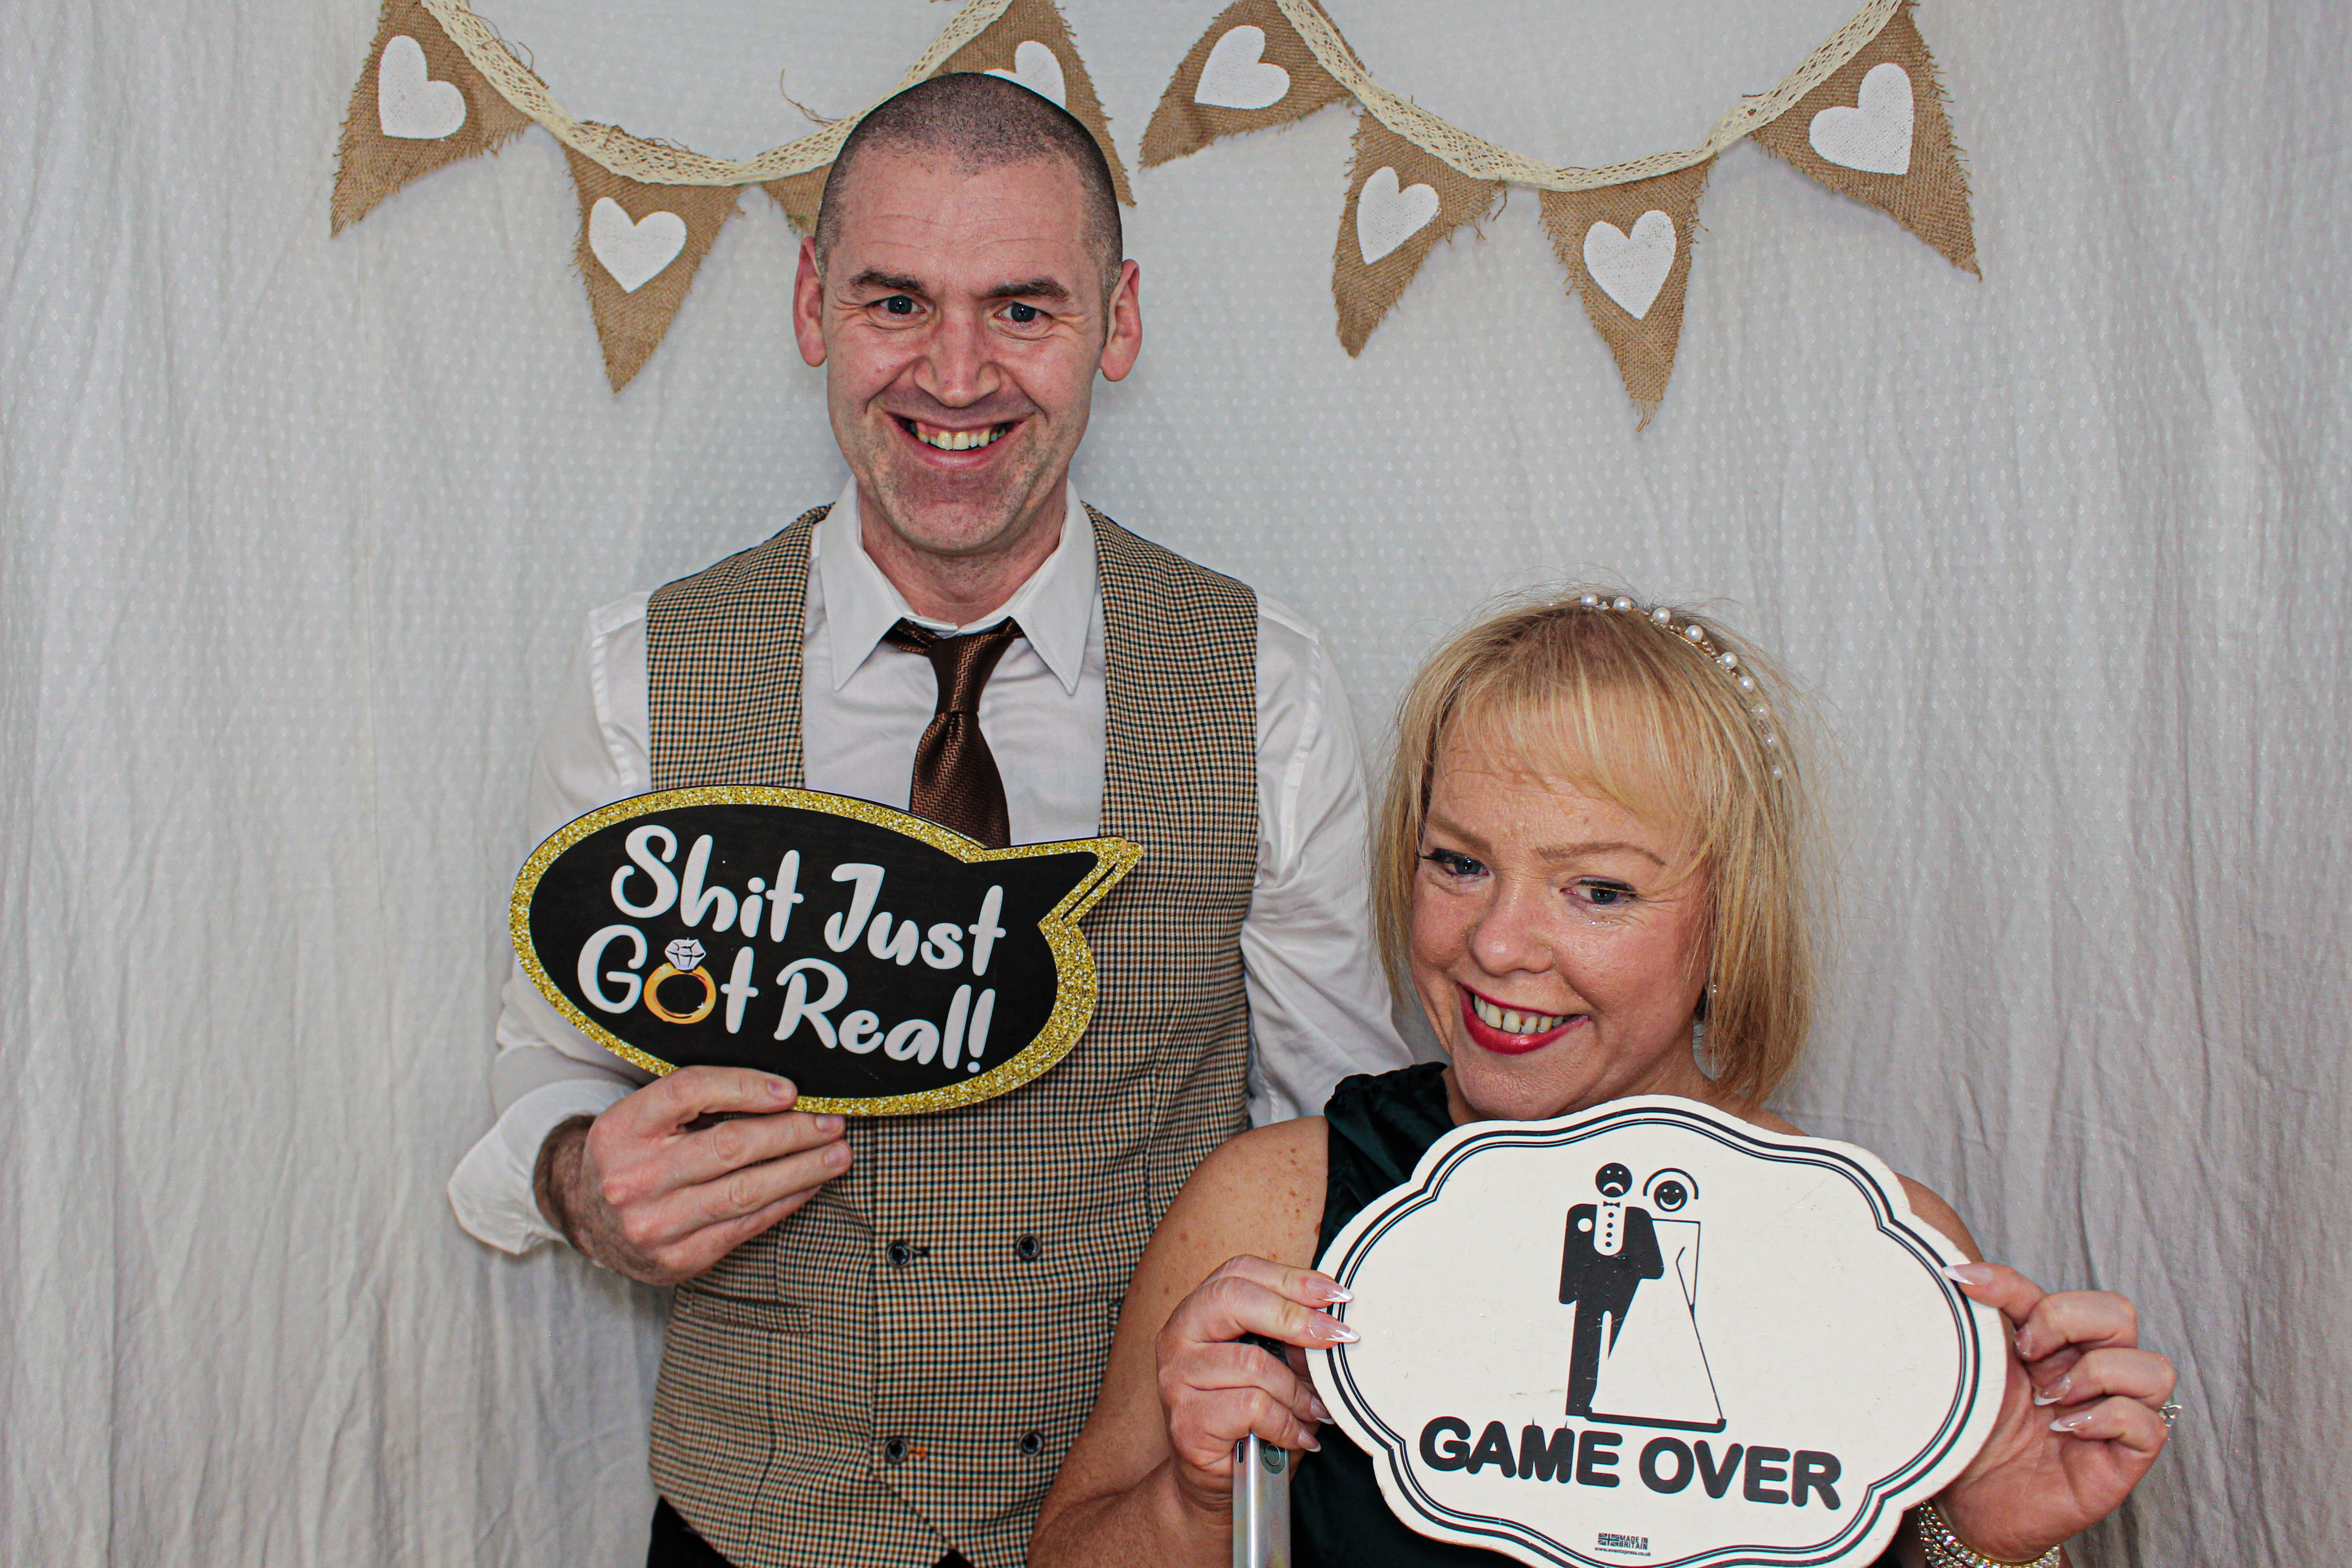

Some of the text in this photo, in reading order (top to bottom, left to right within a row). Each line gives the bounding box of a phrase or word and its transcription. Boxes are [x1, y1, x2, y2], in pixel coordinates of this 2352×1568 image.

[611, 825, 1006, 975] Shit Just
[774, 958, 995, 1073] Real!
[1420, 1416, 1841, 1510] GAME OVER
[1594, 1547, 1651, 1556] www.eventxpress.co.uk
[1619, 1535, 1639, 1543] MADE
[1619, 1541, 1647, 1550] BRITAIN
